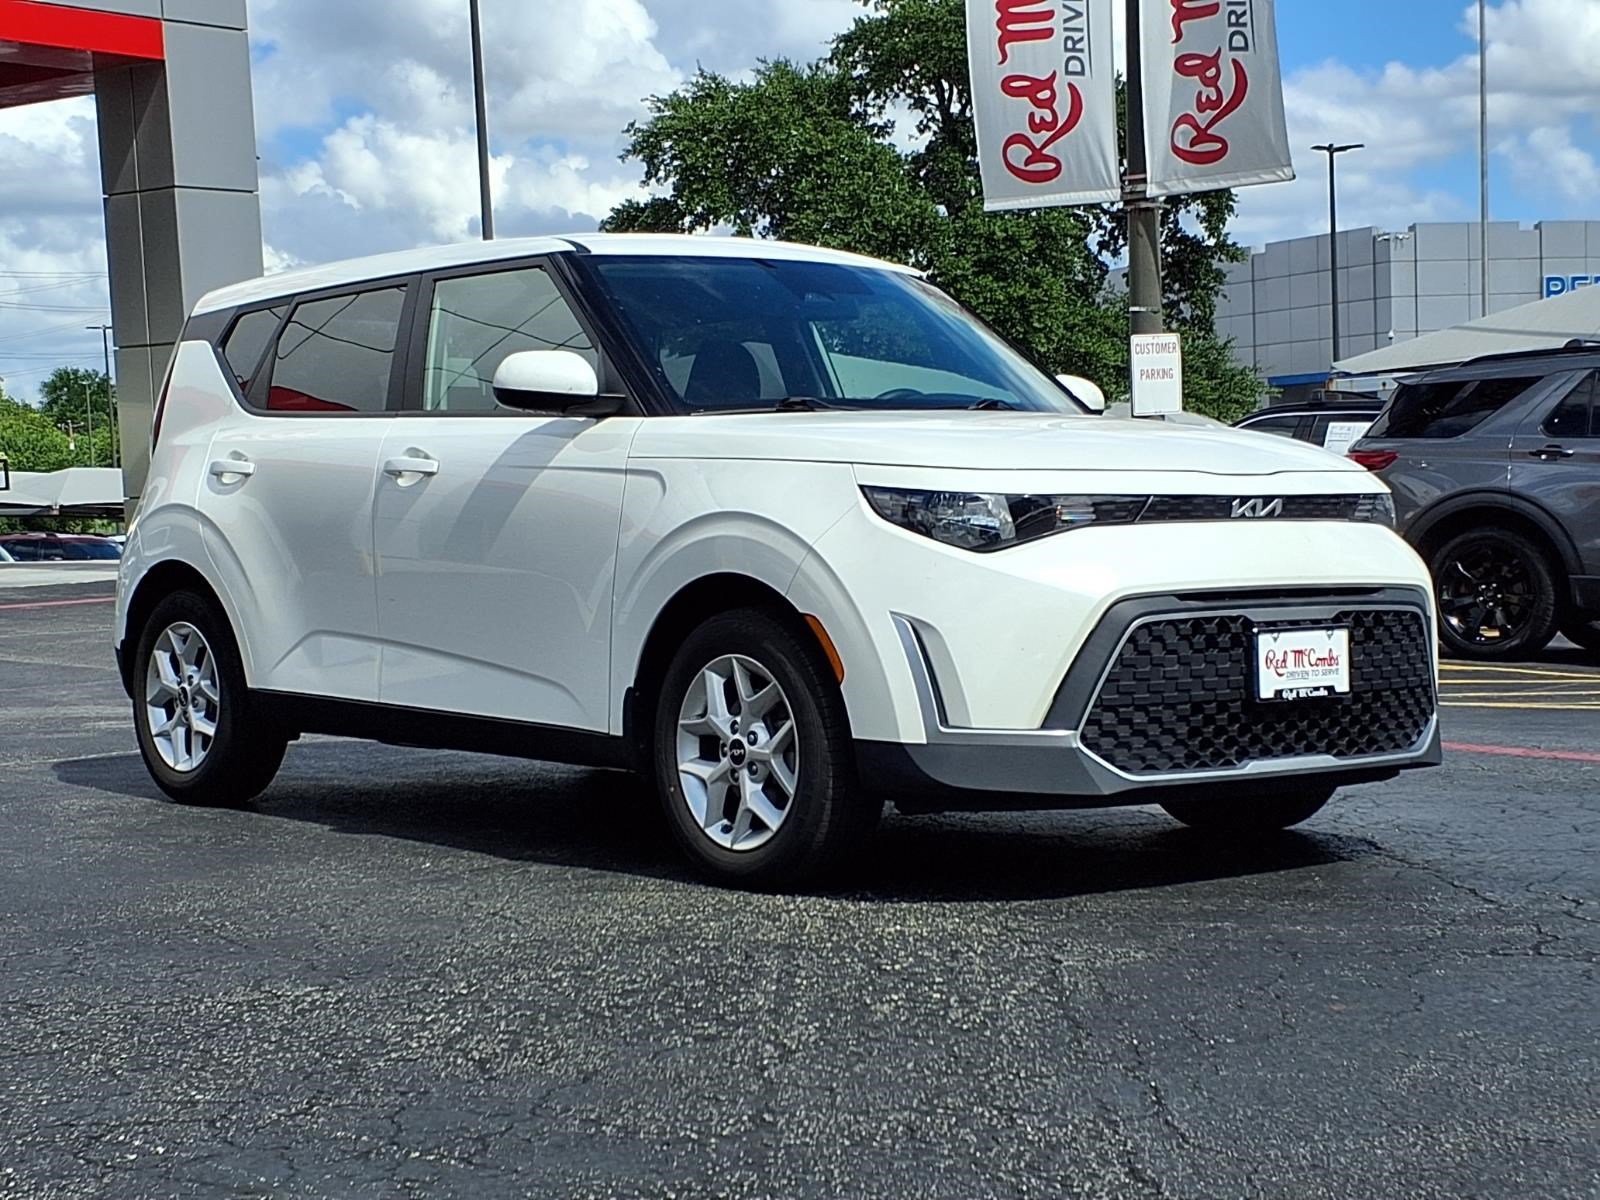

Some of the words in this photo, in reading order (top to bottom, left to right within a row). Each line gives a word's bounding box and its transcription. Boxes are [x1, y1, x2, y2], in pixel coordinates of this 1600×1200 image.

[1062, 0, 1085, 76] DRIV
[1226, 1, 1249, 52] DRI
[1170, 46, 1248, 165] Red
[1001, 69, 1083, 184] Red
[1134, 342, 1177, 355] CUSTOMER
[1140, 368, 1174, 380] PARKING
[1231, 498, 1283, 517] KIA
[1265, 649, 1289, 677] Red
[1286, 670, 1309, 679] DRIVEN
[1312, 669, 1319, 677] TO
[1321, 668, 1339, 676] SERVE
